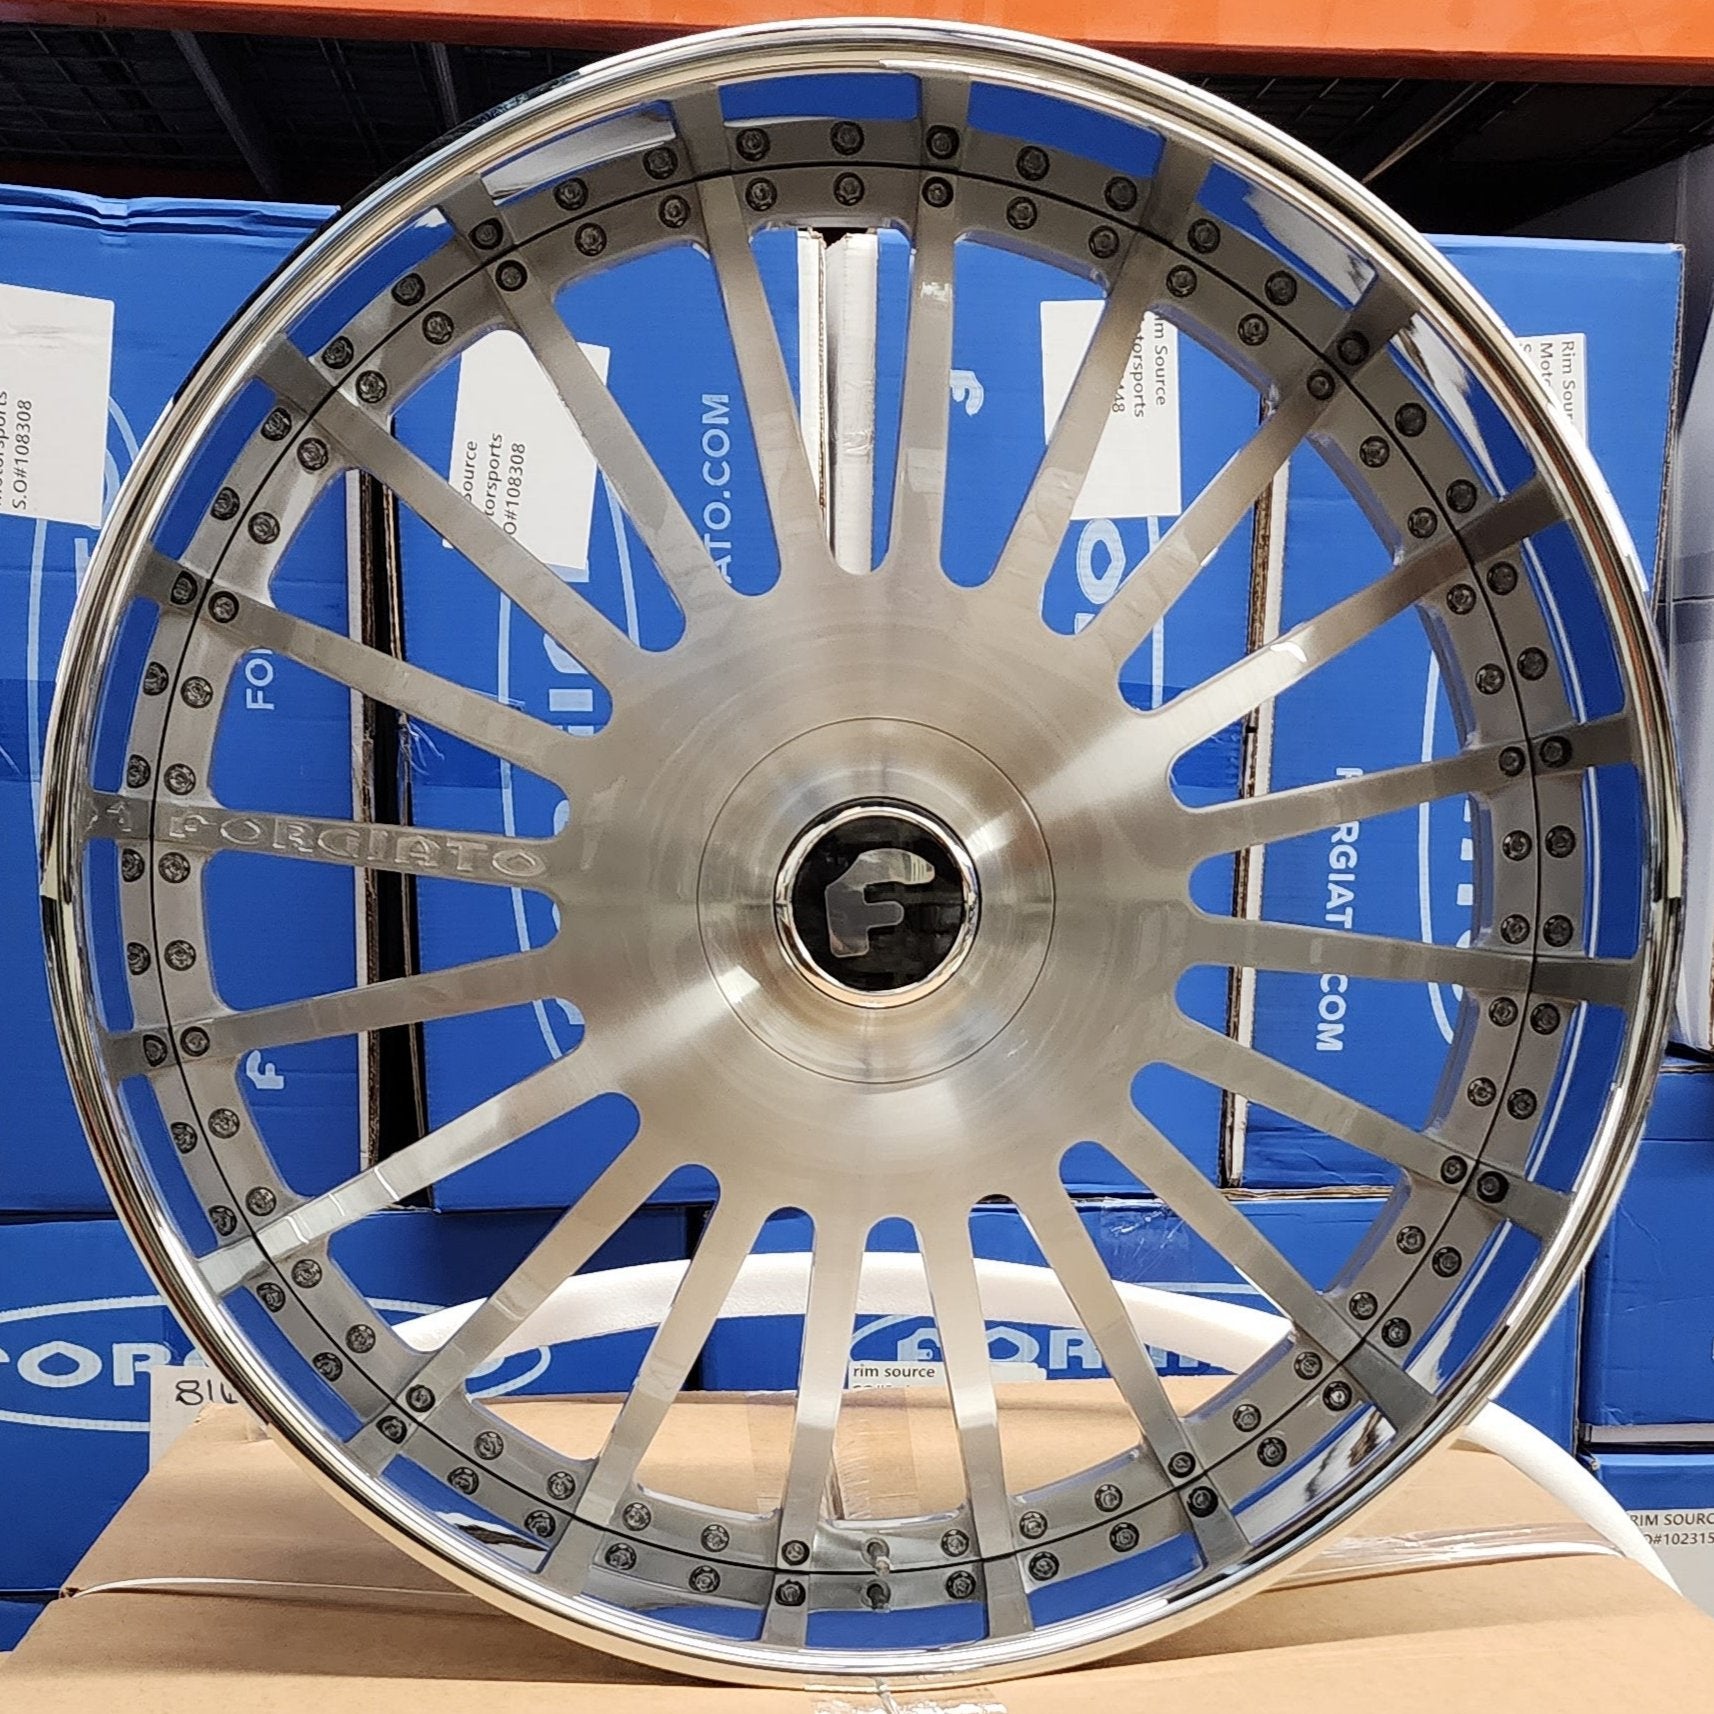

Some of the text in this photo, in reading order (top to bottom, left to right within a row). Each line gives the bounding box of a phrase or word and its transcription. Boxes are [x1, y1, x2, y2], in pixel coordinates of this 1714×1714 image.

[1154, 345, 1168, 405] Source
[1561, 341, 1576, 374] Rim
[12, 399, 32, 510] S.O#108308
[168, 813, 547, 877] FORGIATO
[853, 1364, 935, 1378] rim source
